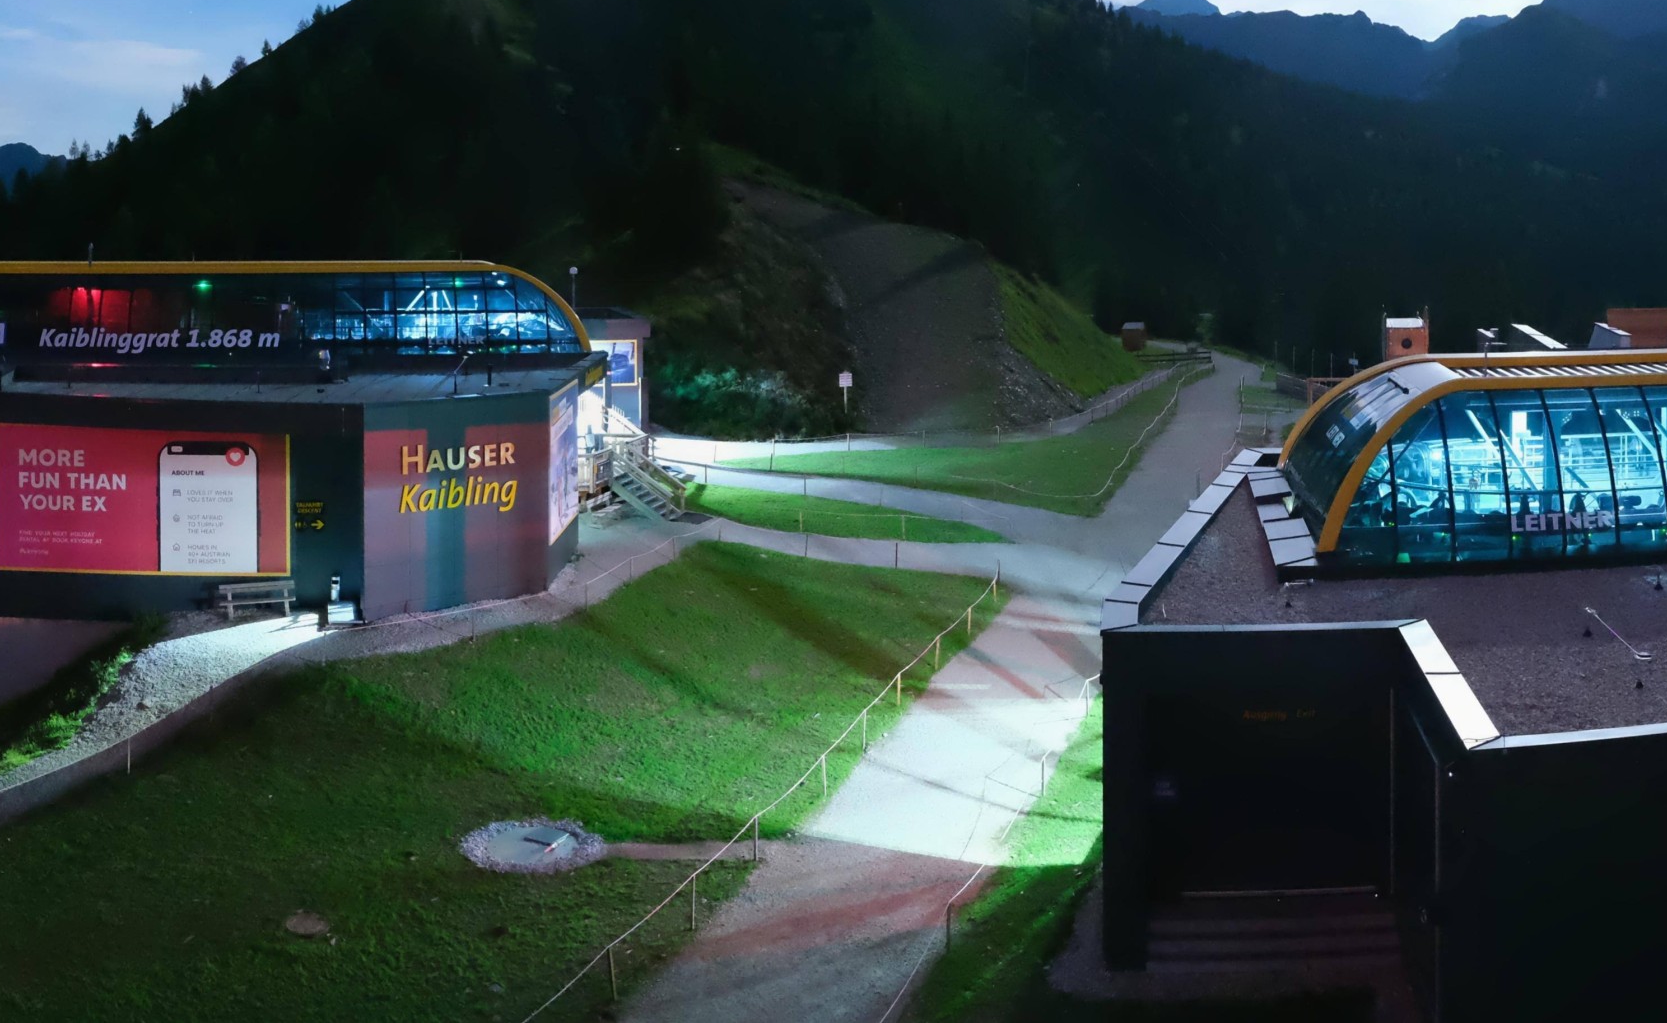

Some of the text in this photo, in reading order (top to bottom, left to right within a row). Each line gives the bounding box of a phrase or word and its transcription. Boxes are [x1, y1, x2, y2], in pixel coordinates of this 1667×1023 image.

[38, 327, 280, 354] Kaiblinggrat 1.868 m
[18, 449, 85, 467] MORE
[401, 442, 516, 475] HAUSER
[18, 471, 127, 490] FUN THAN
[20, 494, 107, 512] YOUR EX
[399, 476, 518, 514] Kaibling
[1511, 510, 1614, 532] LEITNER
